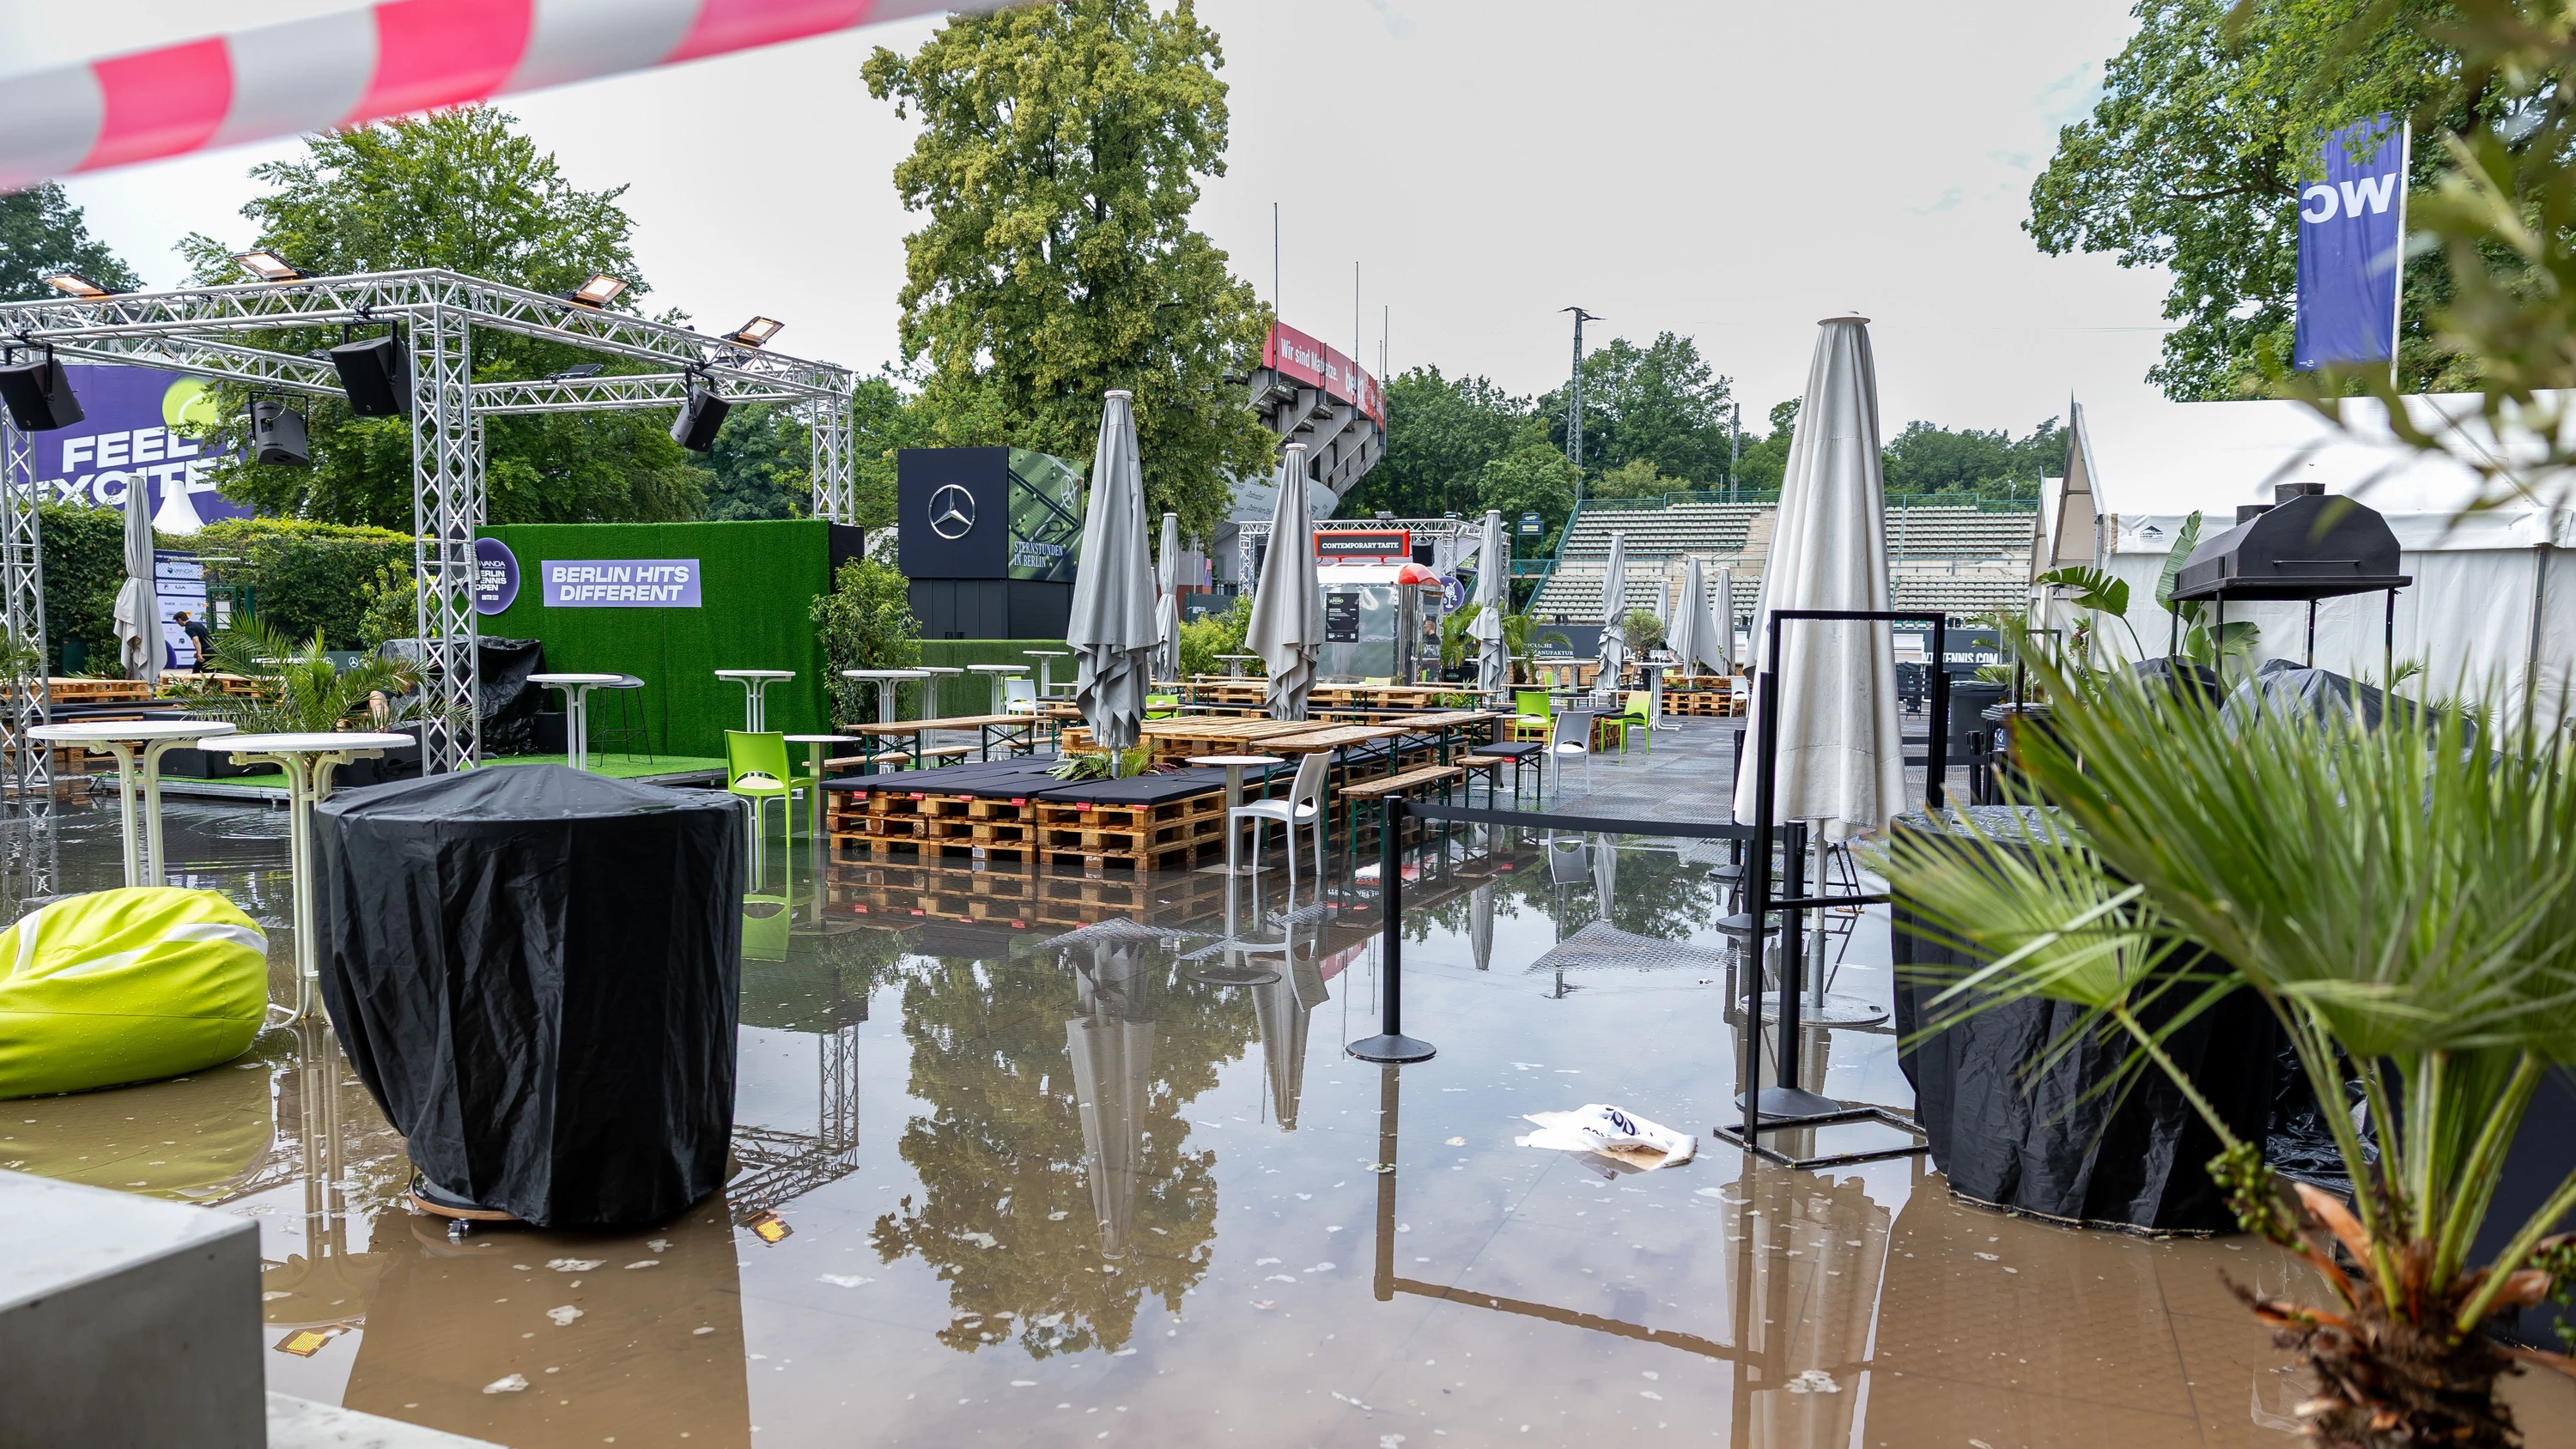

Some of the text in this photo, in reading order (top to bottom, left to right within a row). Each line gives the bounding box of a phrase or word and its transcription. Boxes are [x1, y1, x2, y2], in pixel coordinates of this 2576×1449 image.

[1281, 337, 1294, 361] Wir
[1295, 345, 1309, 368] sind
[62, 425, 198, 473] FEEL
[1014, 541, 1063, 556] STERNSTUNDEN
[1014, 554, 1047, 567] IN BERLIN
[551, 566, 690, 583] BERLIN HITS
[559, 585, 683, 601] DIFFERENT
[1923, 652, 1999, 664] WTTENNIS.COM
